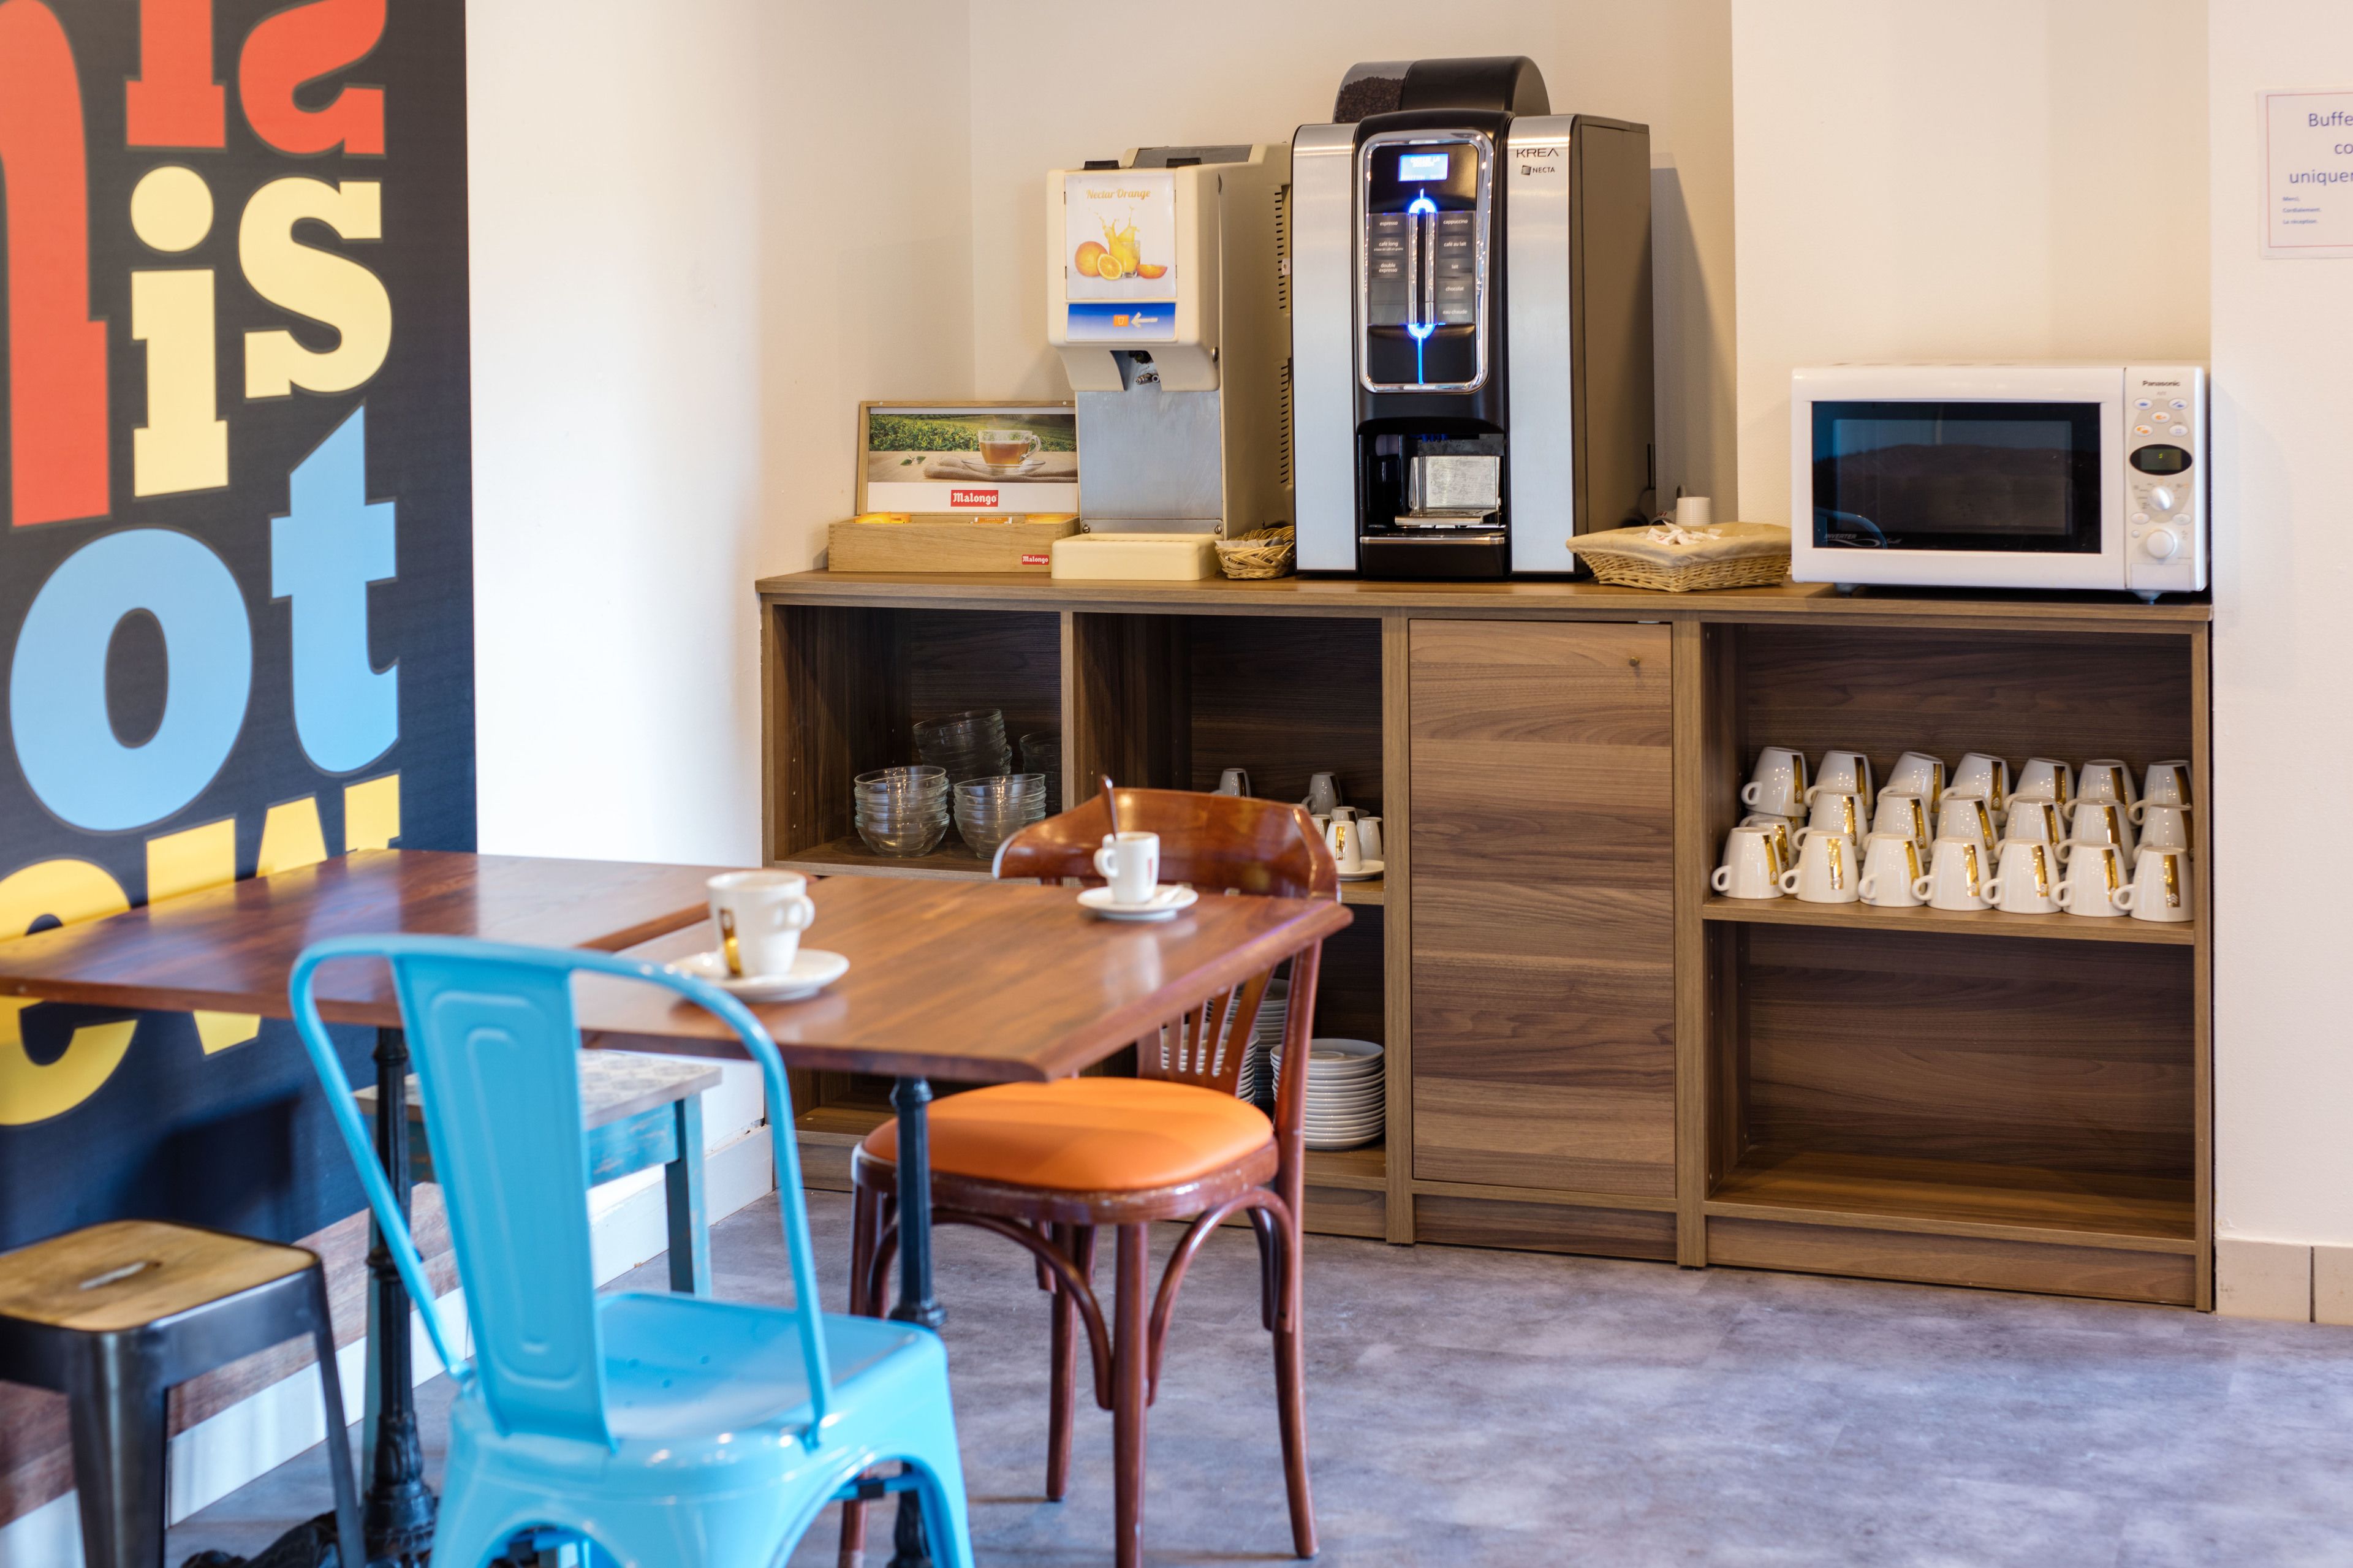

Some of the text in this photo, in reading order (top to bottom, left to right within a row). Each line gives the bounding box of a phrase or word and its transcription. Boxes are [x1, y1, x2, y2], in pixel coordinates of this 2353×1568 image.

[2308, 112, 2353, 127] Buffe
[1516, 148, 1559, 158] KREA
[1086, 187, 1151, 200] Nectar Orange
[131, 166, 392, 496] is
[953, 492, 998, 506] Malongo
[1022, 556, 1048, 564] Malongo
